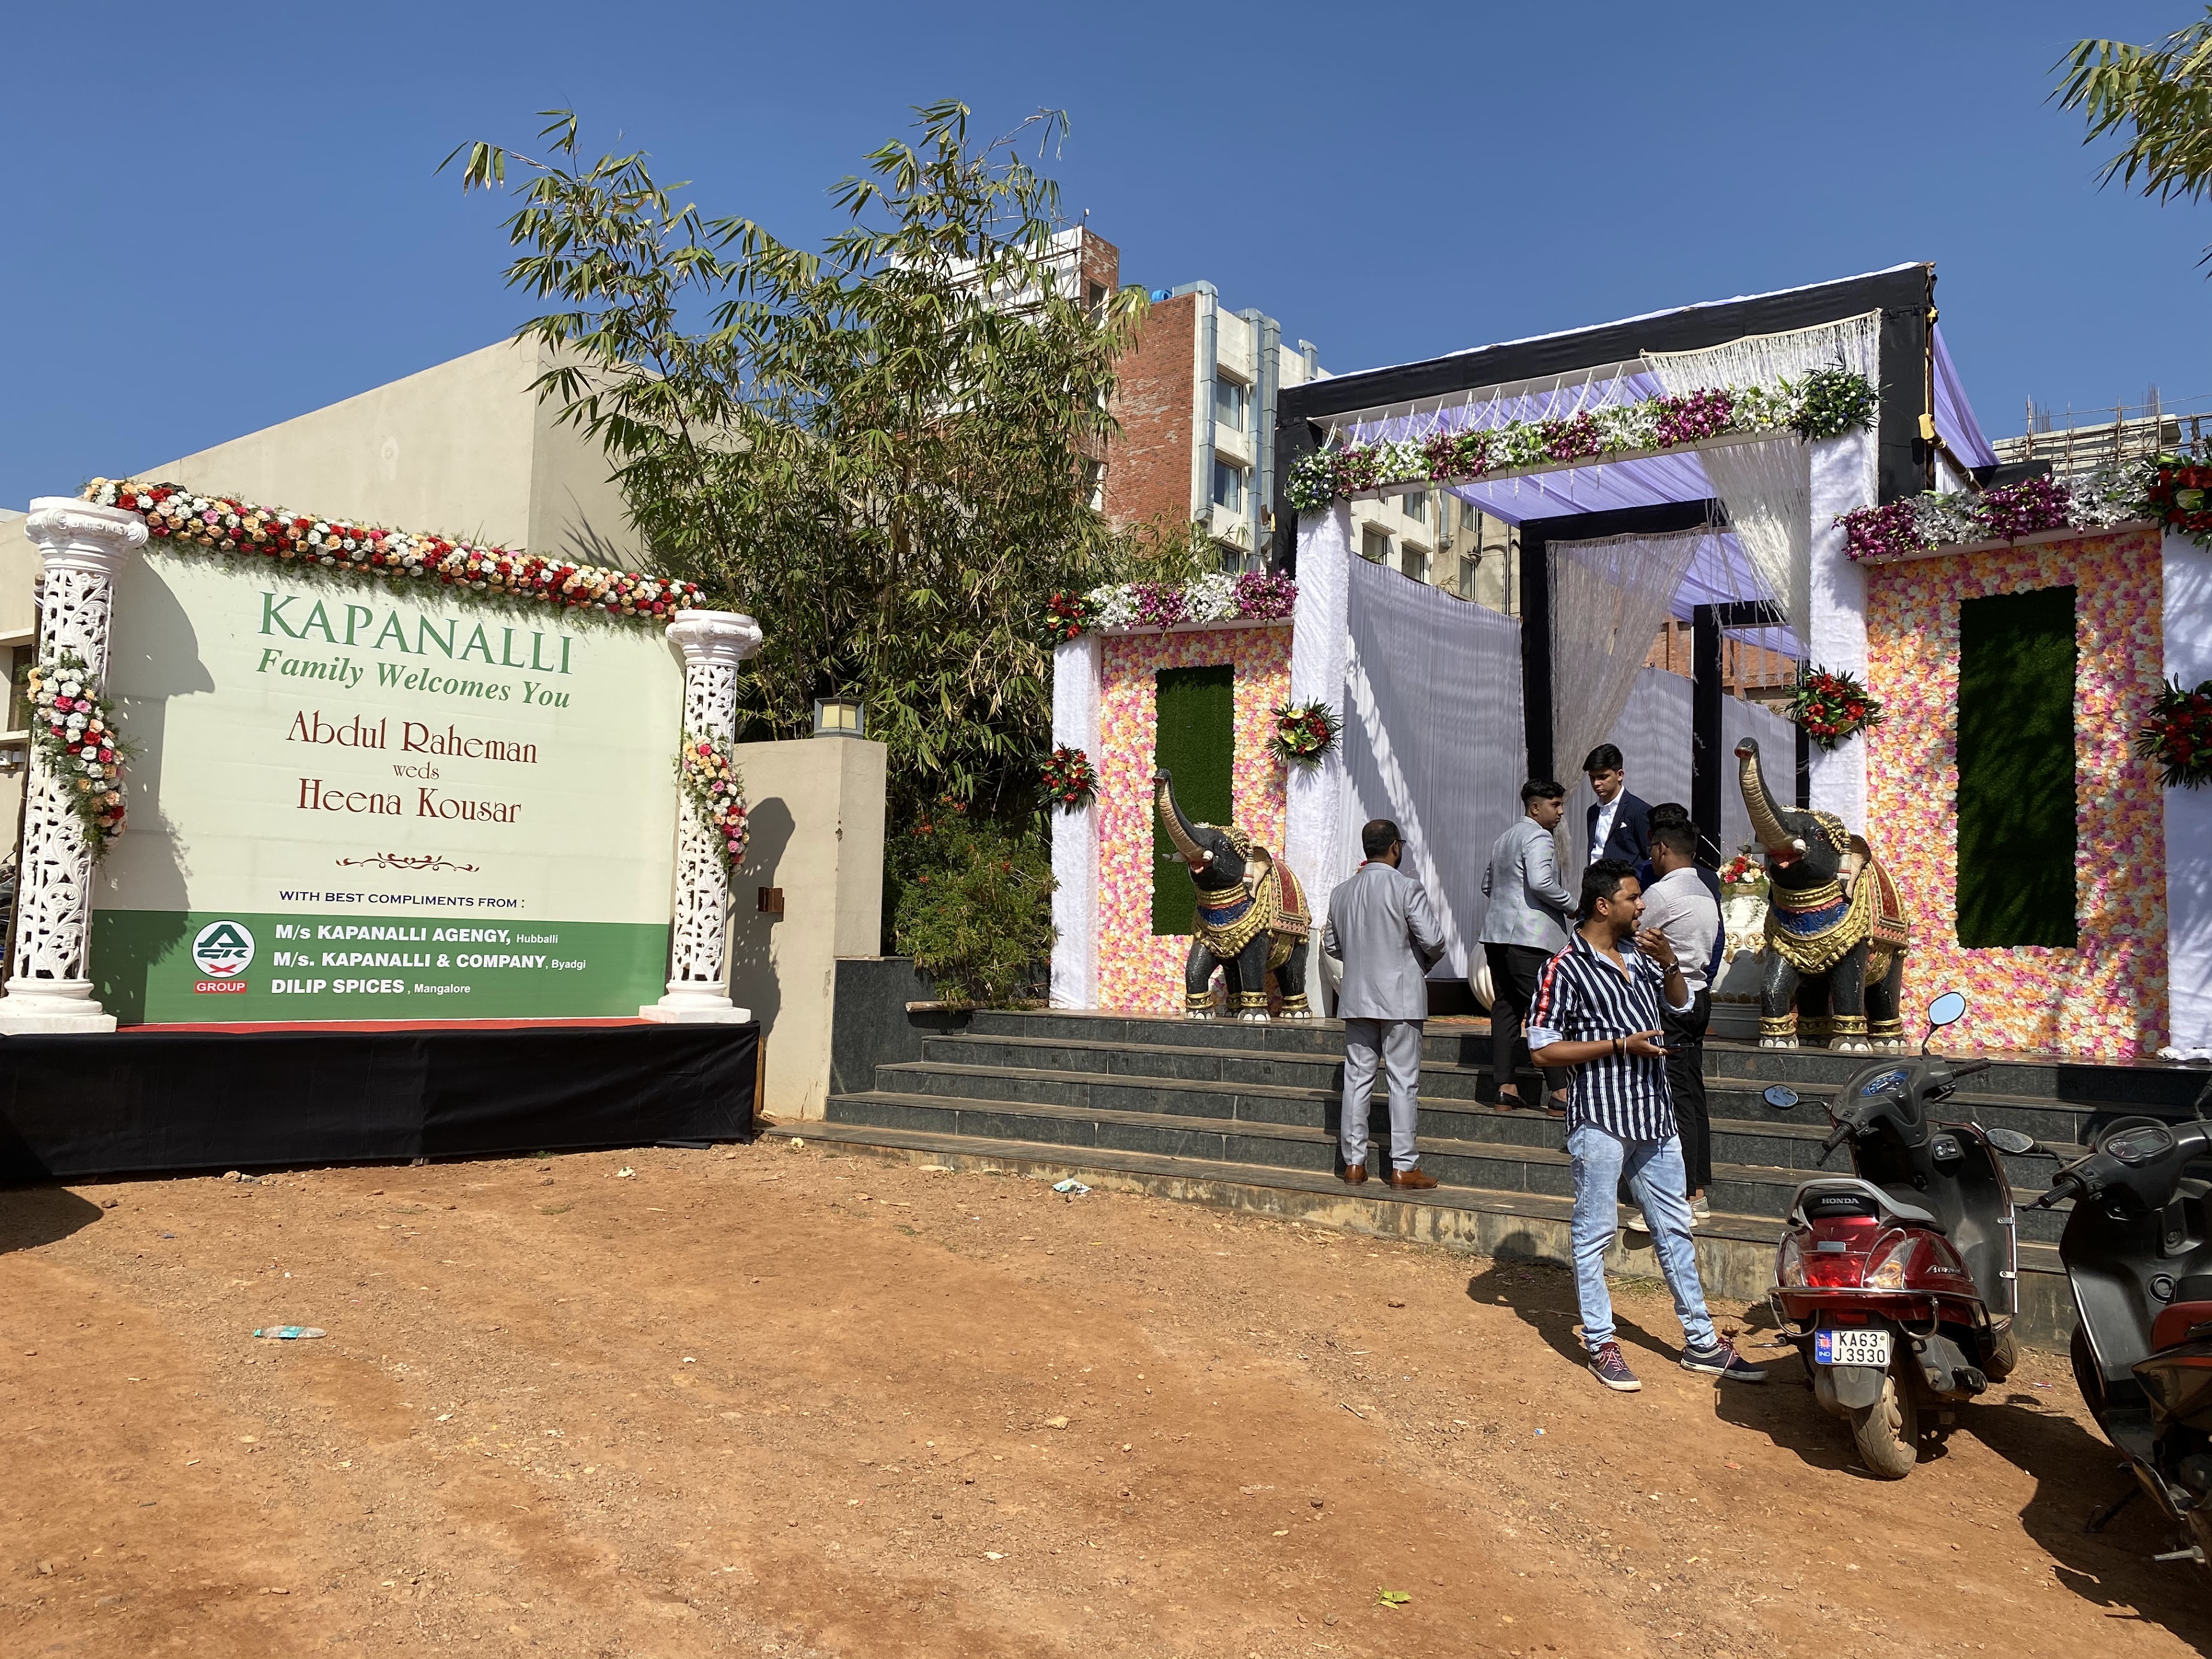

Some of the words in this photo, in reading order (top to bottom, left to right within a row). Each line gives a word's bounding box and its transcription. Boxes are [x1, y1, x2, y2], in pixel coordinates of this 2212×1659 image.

[256, 591, 573, 675] KAPANALLI
[256, 647, 364, 690] Family
[376, 662, 512, 701] Welcomes
[522, 680, 570, 708] You
[285, 710, 387, 749] Abdul
[400, 721, 538, 764] Raheman
[392, 761, 440, 780] weds
[297, 778, 403, 816] Heena
[416, 787, 522, 823] Kousar
[279, 891, 320, 902] WITH
[324, 892, 365, 903] BEST
[368, 893, 475, 907] COMPLIMENTS
[275, 924, 312, 941] M/s
[317, 925, 427, 941] KAPANALLI
[431, 927, 512, 946] AGENGY,
[516, 934, 558, 944] Hubballi
[273, 951, 315, 968] M/s.
[321, 952, 431, 967] KAPANALLI
[436, 953, 451, 968] &
[456, 954, 548, 970] COMPANY,
[551, 959, 586, 971] Byadgi
[196, 982, 245, 992] GROUP
[271, 979, 327, 994] DILIP
[332, 979, 404, 994] SPICES
[414, 984, 471, 996] Mangalore
[1839, 1332, 1878, 1347] KA63
